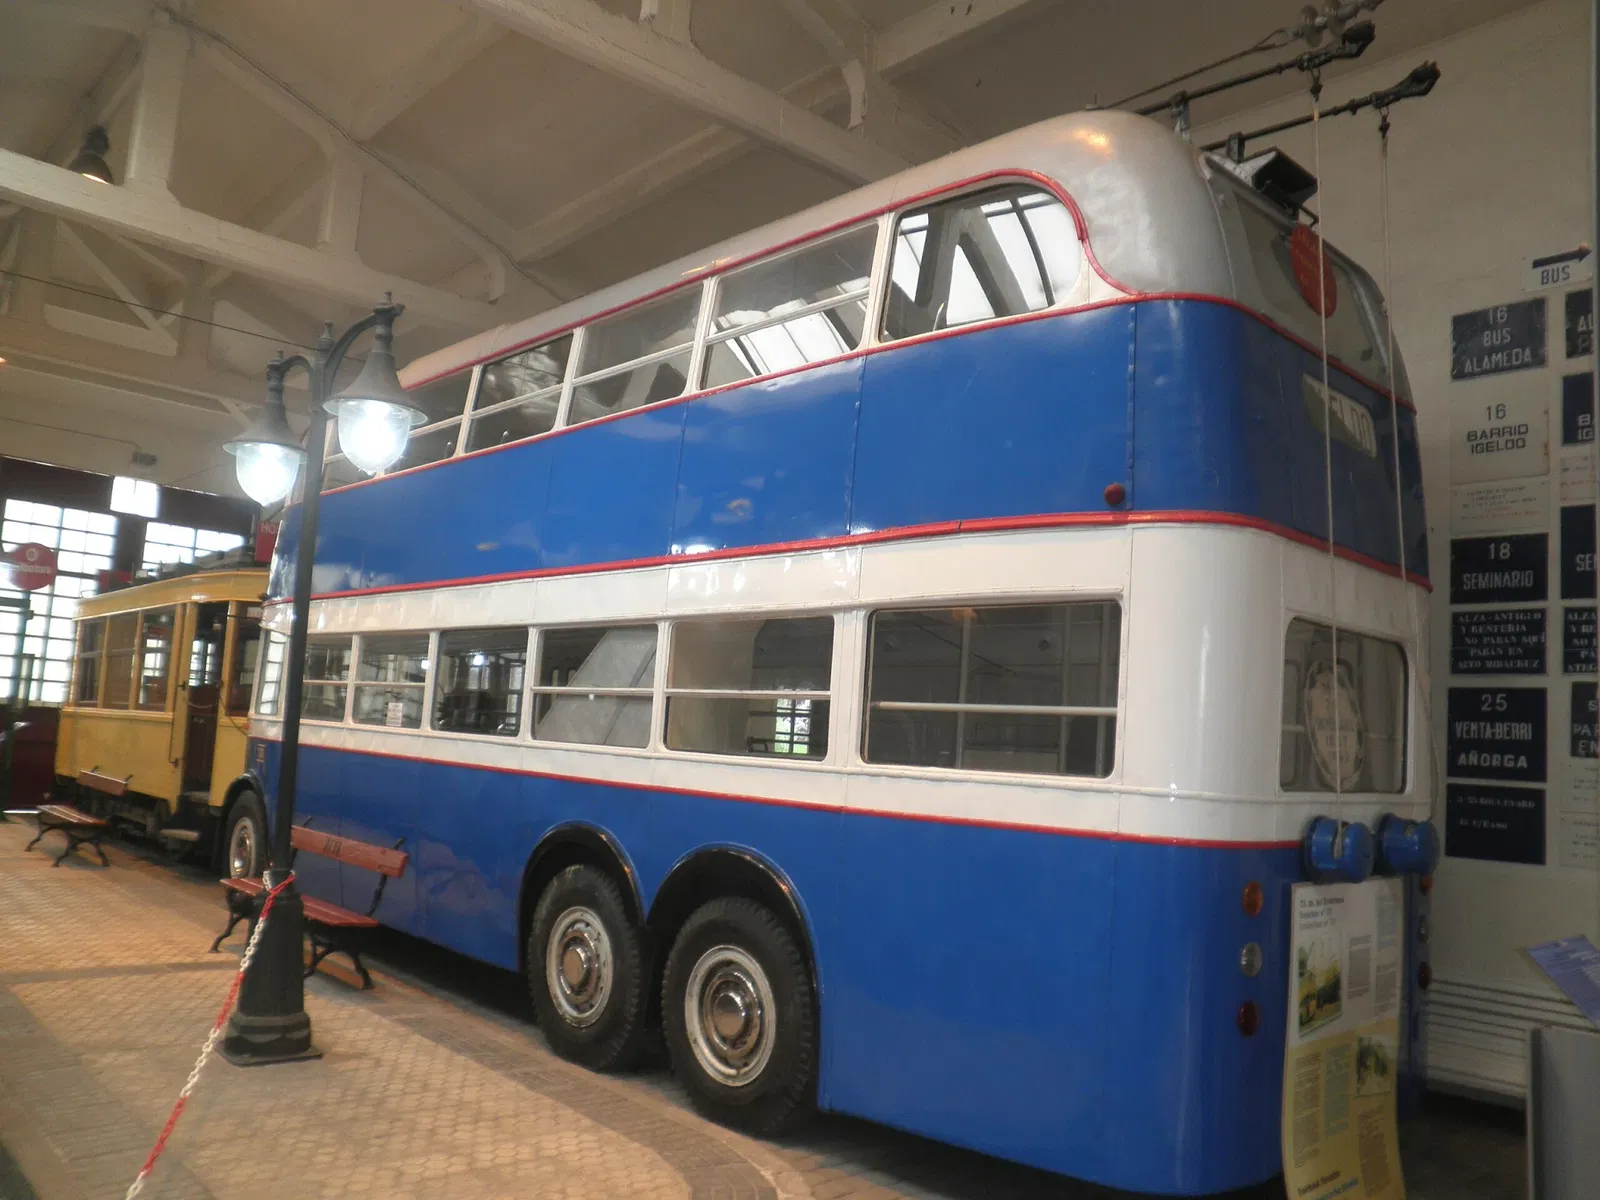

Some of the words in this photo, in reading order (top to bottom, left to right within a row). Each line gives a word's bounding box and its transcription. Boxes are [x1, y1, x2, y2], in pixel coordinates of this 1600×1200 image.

[1541, 265, 1570, 285] BUS
[1488, 306, 1508, 325] 16
[1483, 328, 1511, 346] BUS
[1464, 348, 1532, 373] ALAMEDA
[1487, 403, 1507, 421] 16
[1467, 424, 1529, 442] BARRIO
[1489, 542, 1511, 560] 18
[1463, 570, 1534, 590] SEMINARIO
[1481, 693, 1508, 712] 25
[1455, 720, 1533, 740] VENTA-BERRI
[1458, 750, 1528, 769] AÑORGA
